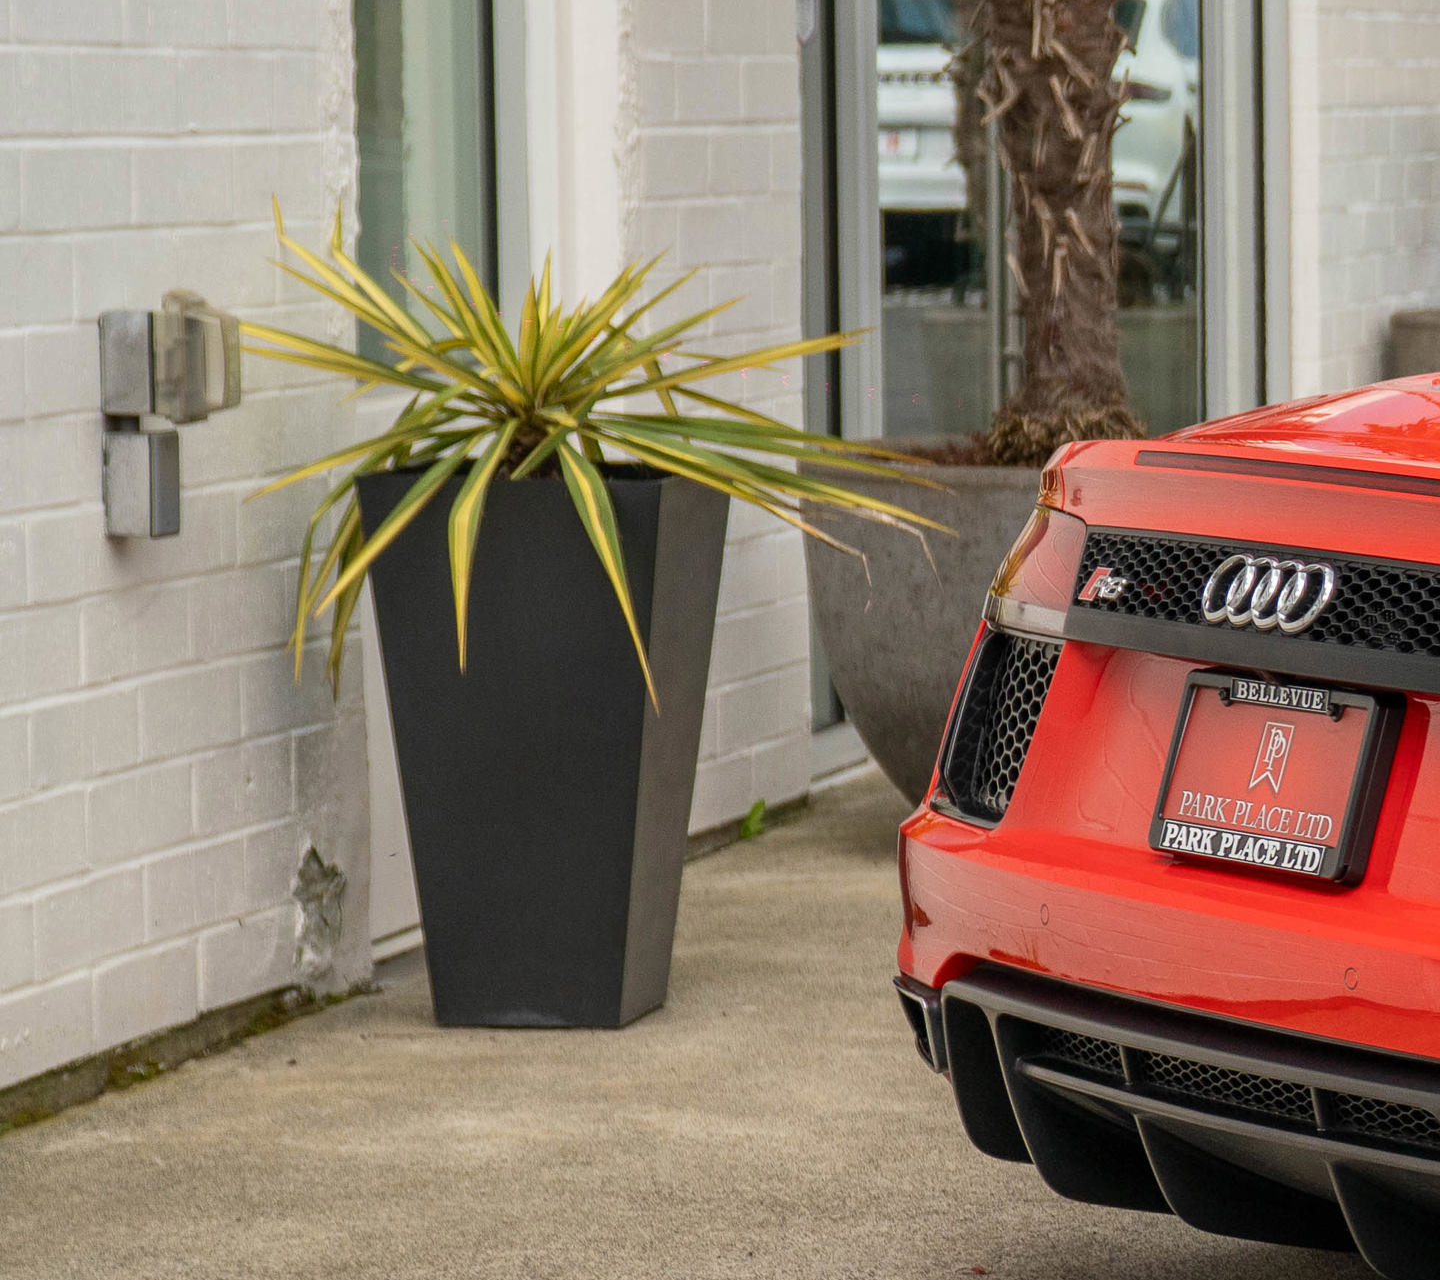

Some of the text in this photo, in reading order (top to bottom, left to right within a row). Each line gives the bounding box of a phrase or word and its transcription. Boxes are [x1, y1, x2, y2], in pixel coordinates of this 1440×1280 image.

[1078, 566, 1128, 601] R8
[1236, 681, 1324, 709] BELLEVUE
[1178, 790, 1333, 841] PARK PLACE LTD
[1162, 823, 1321, 872] PARK PLACE LTD
